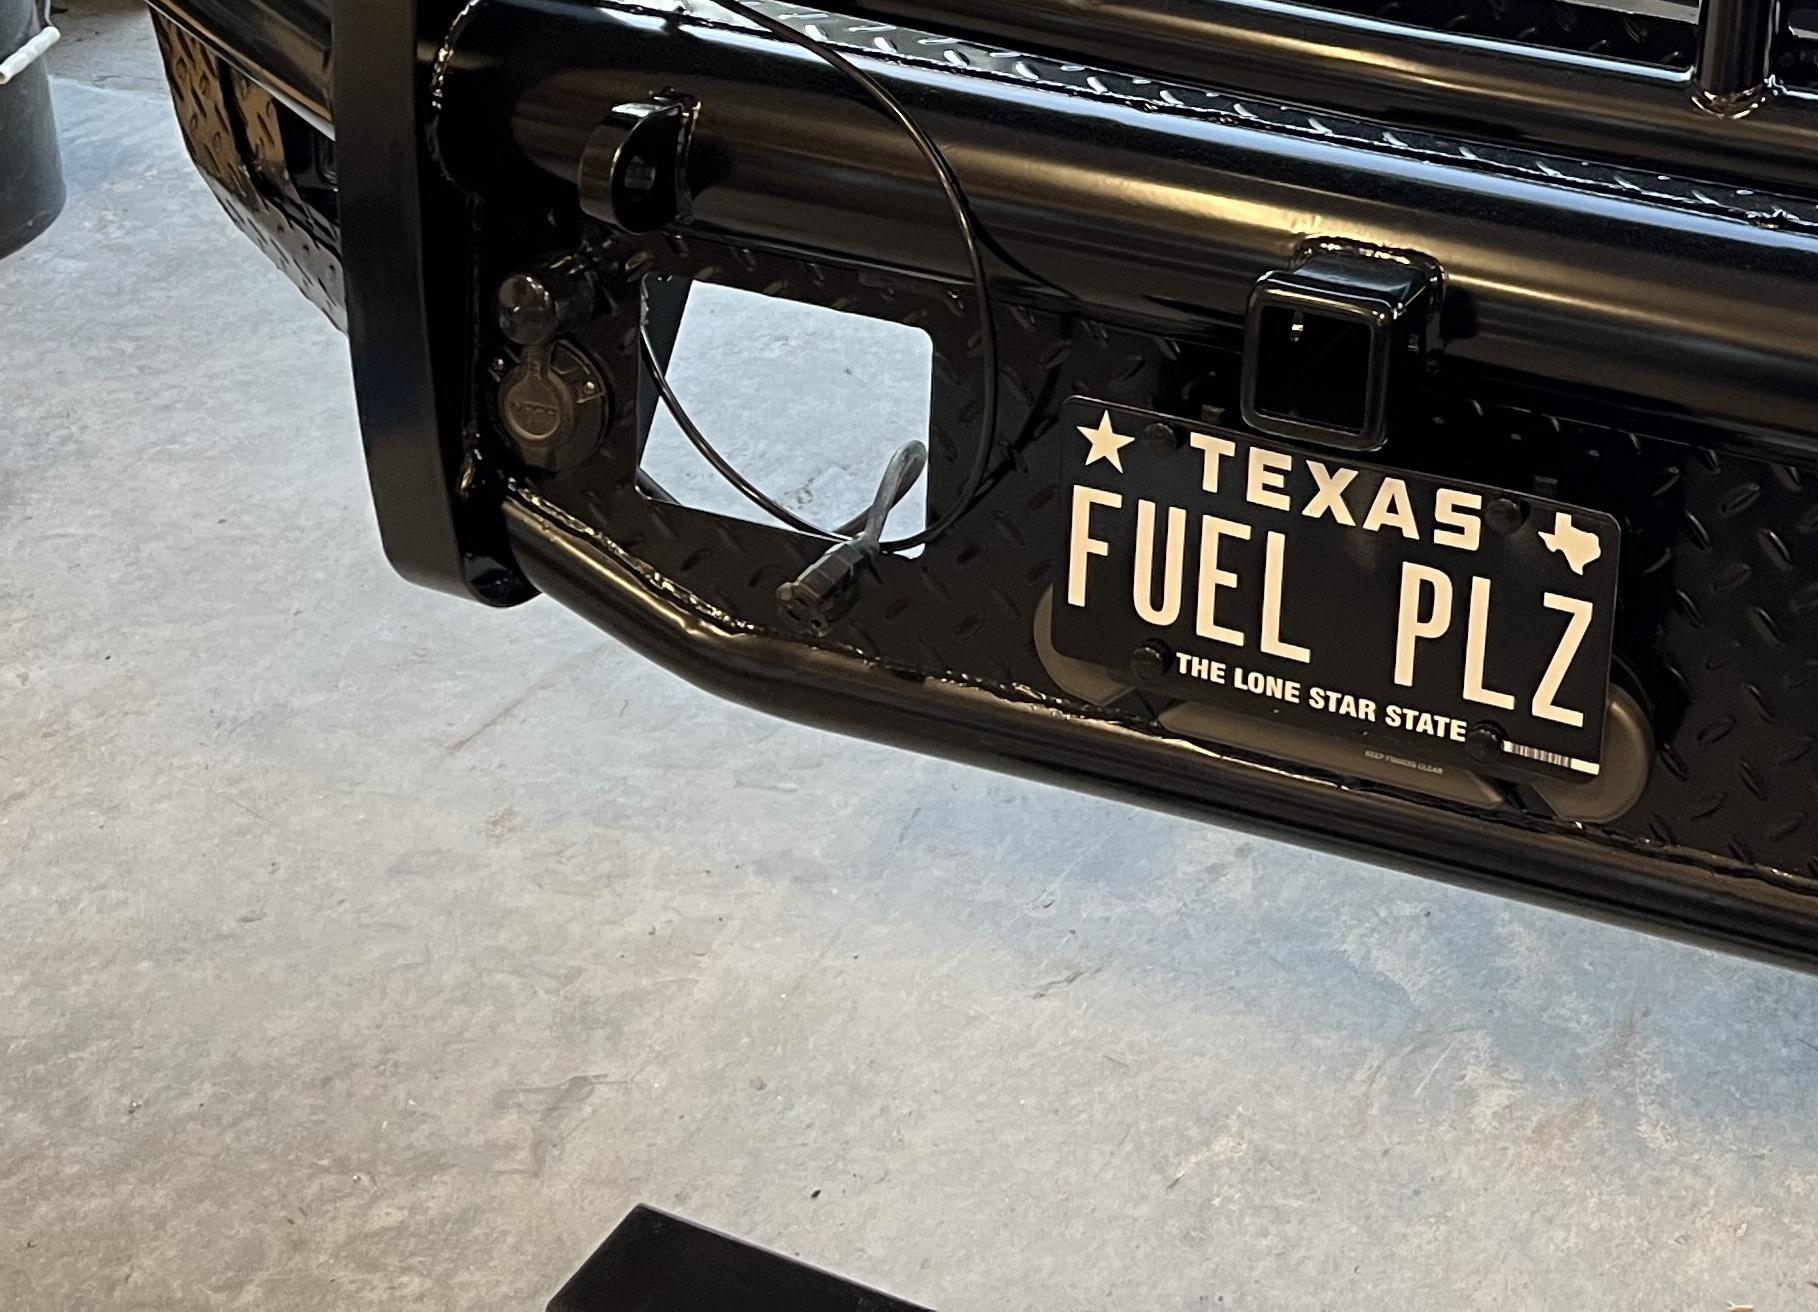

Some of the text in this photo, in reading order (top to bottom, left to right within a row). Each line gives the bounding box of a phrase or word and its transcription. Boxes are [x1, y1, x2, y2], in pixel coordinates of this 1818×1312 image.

[1190, 431, 1482, 551] TEXAS
[1067, 484, 1594, 728] FUEL PLZ
[1176, 652, 1467, 742] THE LONE STAR STATE
